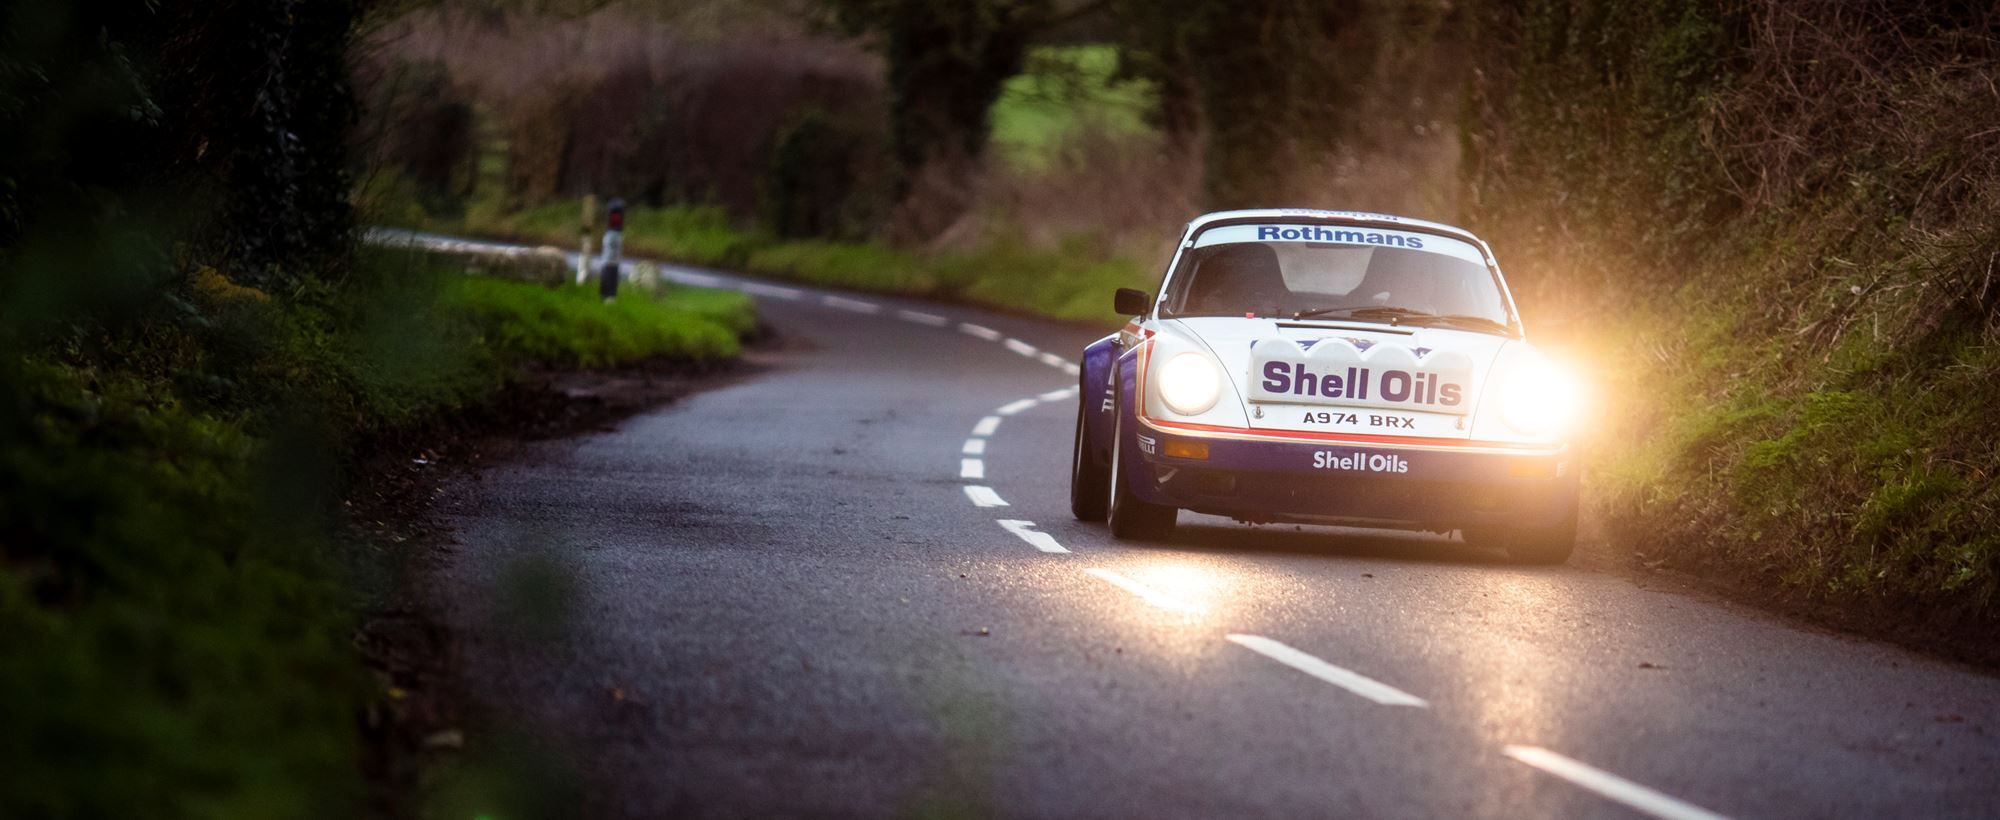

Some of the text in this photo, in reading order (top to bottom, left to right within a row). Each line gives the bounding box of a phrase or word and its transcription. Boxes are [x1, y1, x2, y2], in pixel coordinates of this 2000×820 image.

[1257, 225, 1424, 249] Rothmans
[1262, 361, 1463, 407] Shell Oils
[1303, 412, 1415, 429] A974 BRX
[1313, 451, 1409, 473] Shell Oils
